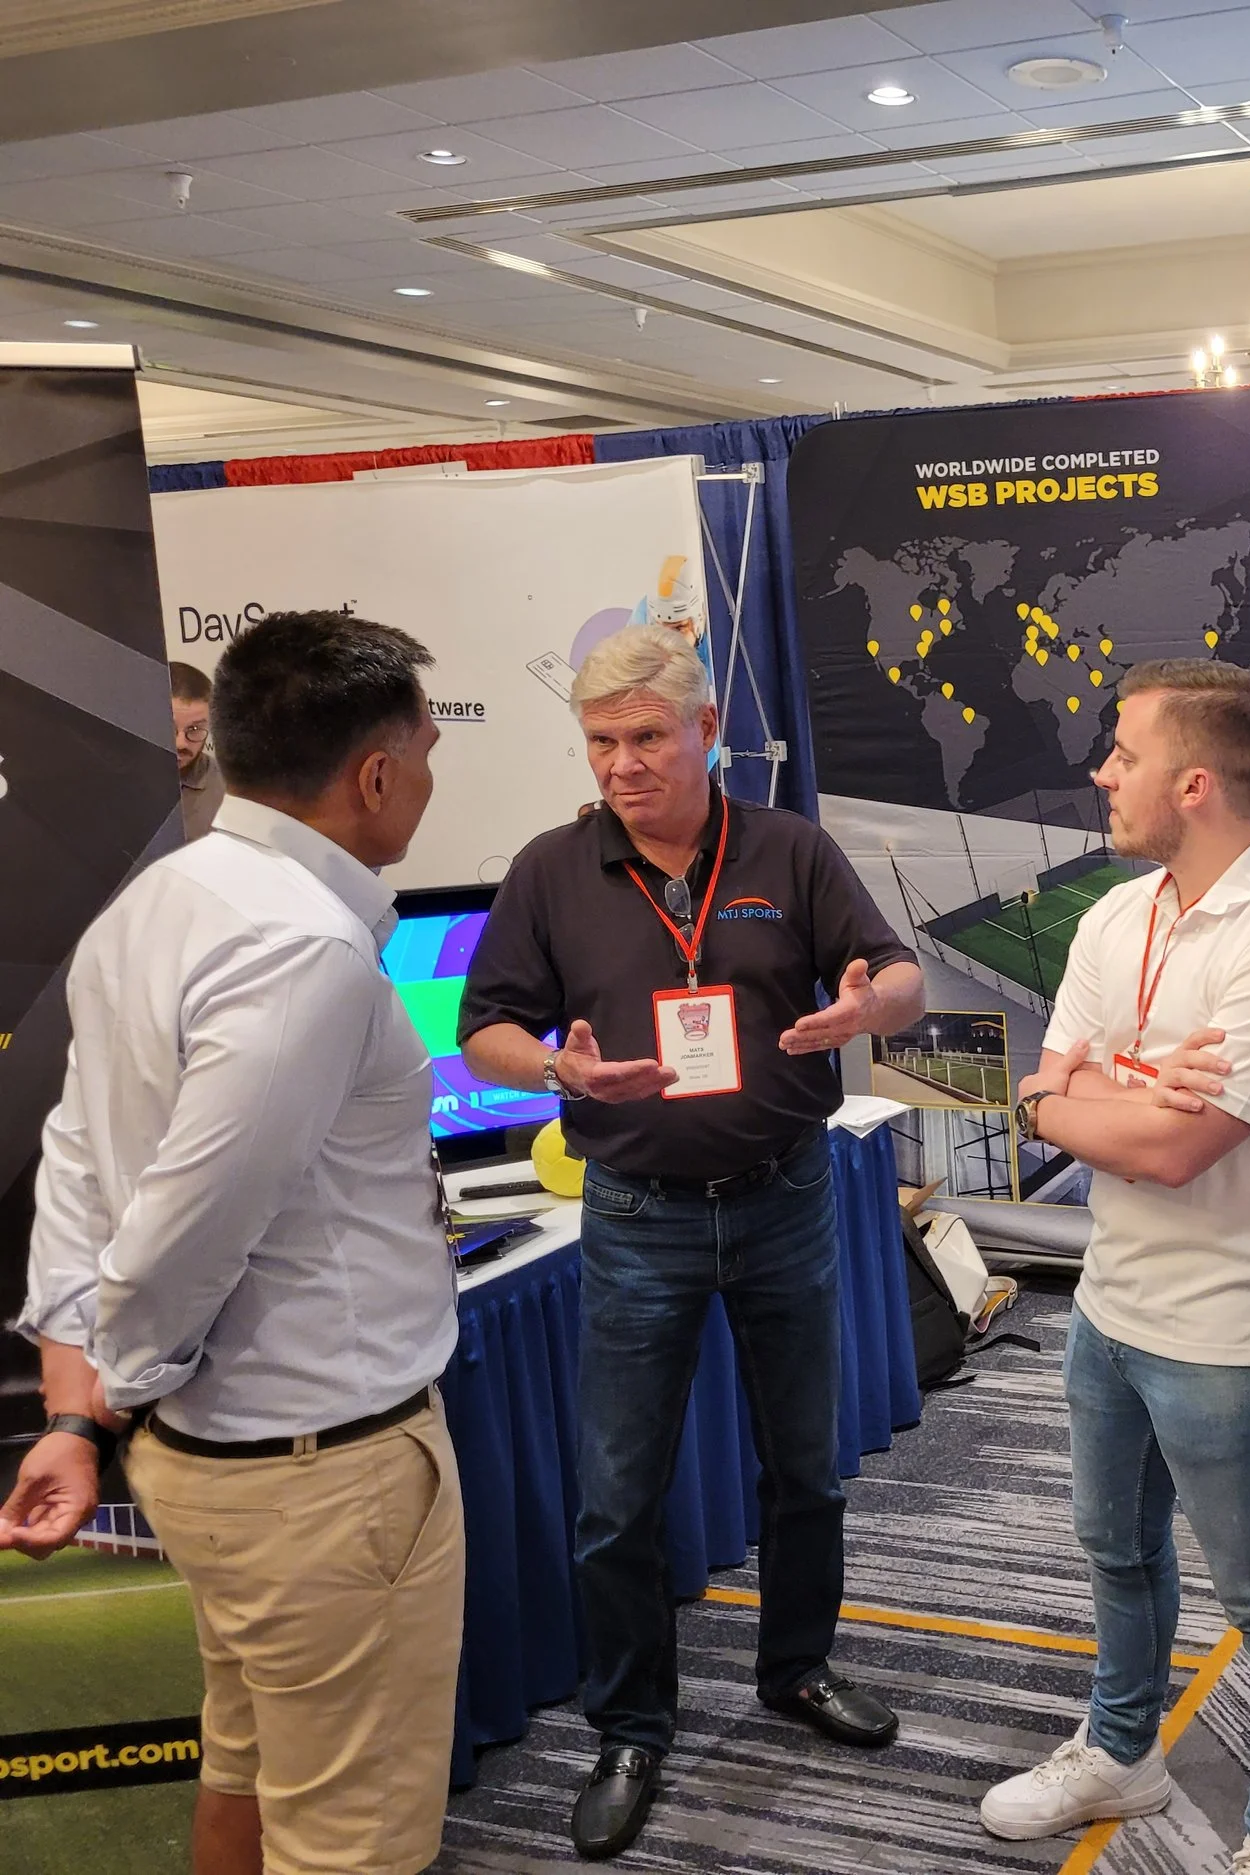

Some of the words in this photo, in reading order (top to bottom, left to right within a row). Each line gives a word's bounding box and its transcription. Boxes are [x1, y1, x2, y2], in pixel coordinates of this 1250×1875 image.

[915, 456, 1036, 479] WORLDWIDE
[1042, 449, 1160, 471] COMPLETED
[916, 482, 989, 510] WSB
[995, 472, 1159, 505] PROJECTS
[717, 908, 739, 920] MTJ
[741, 907, 783, 920] SPORTS
